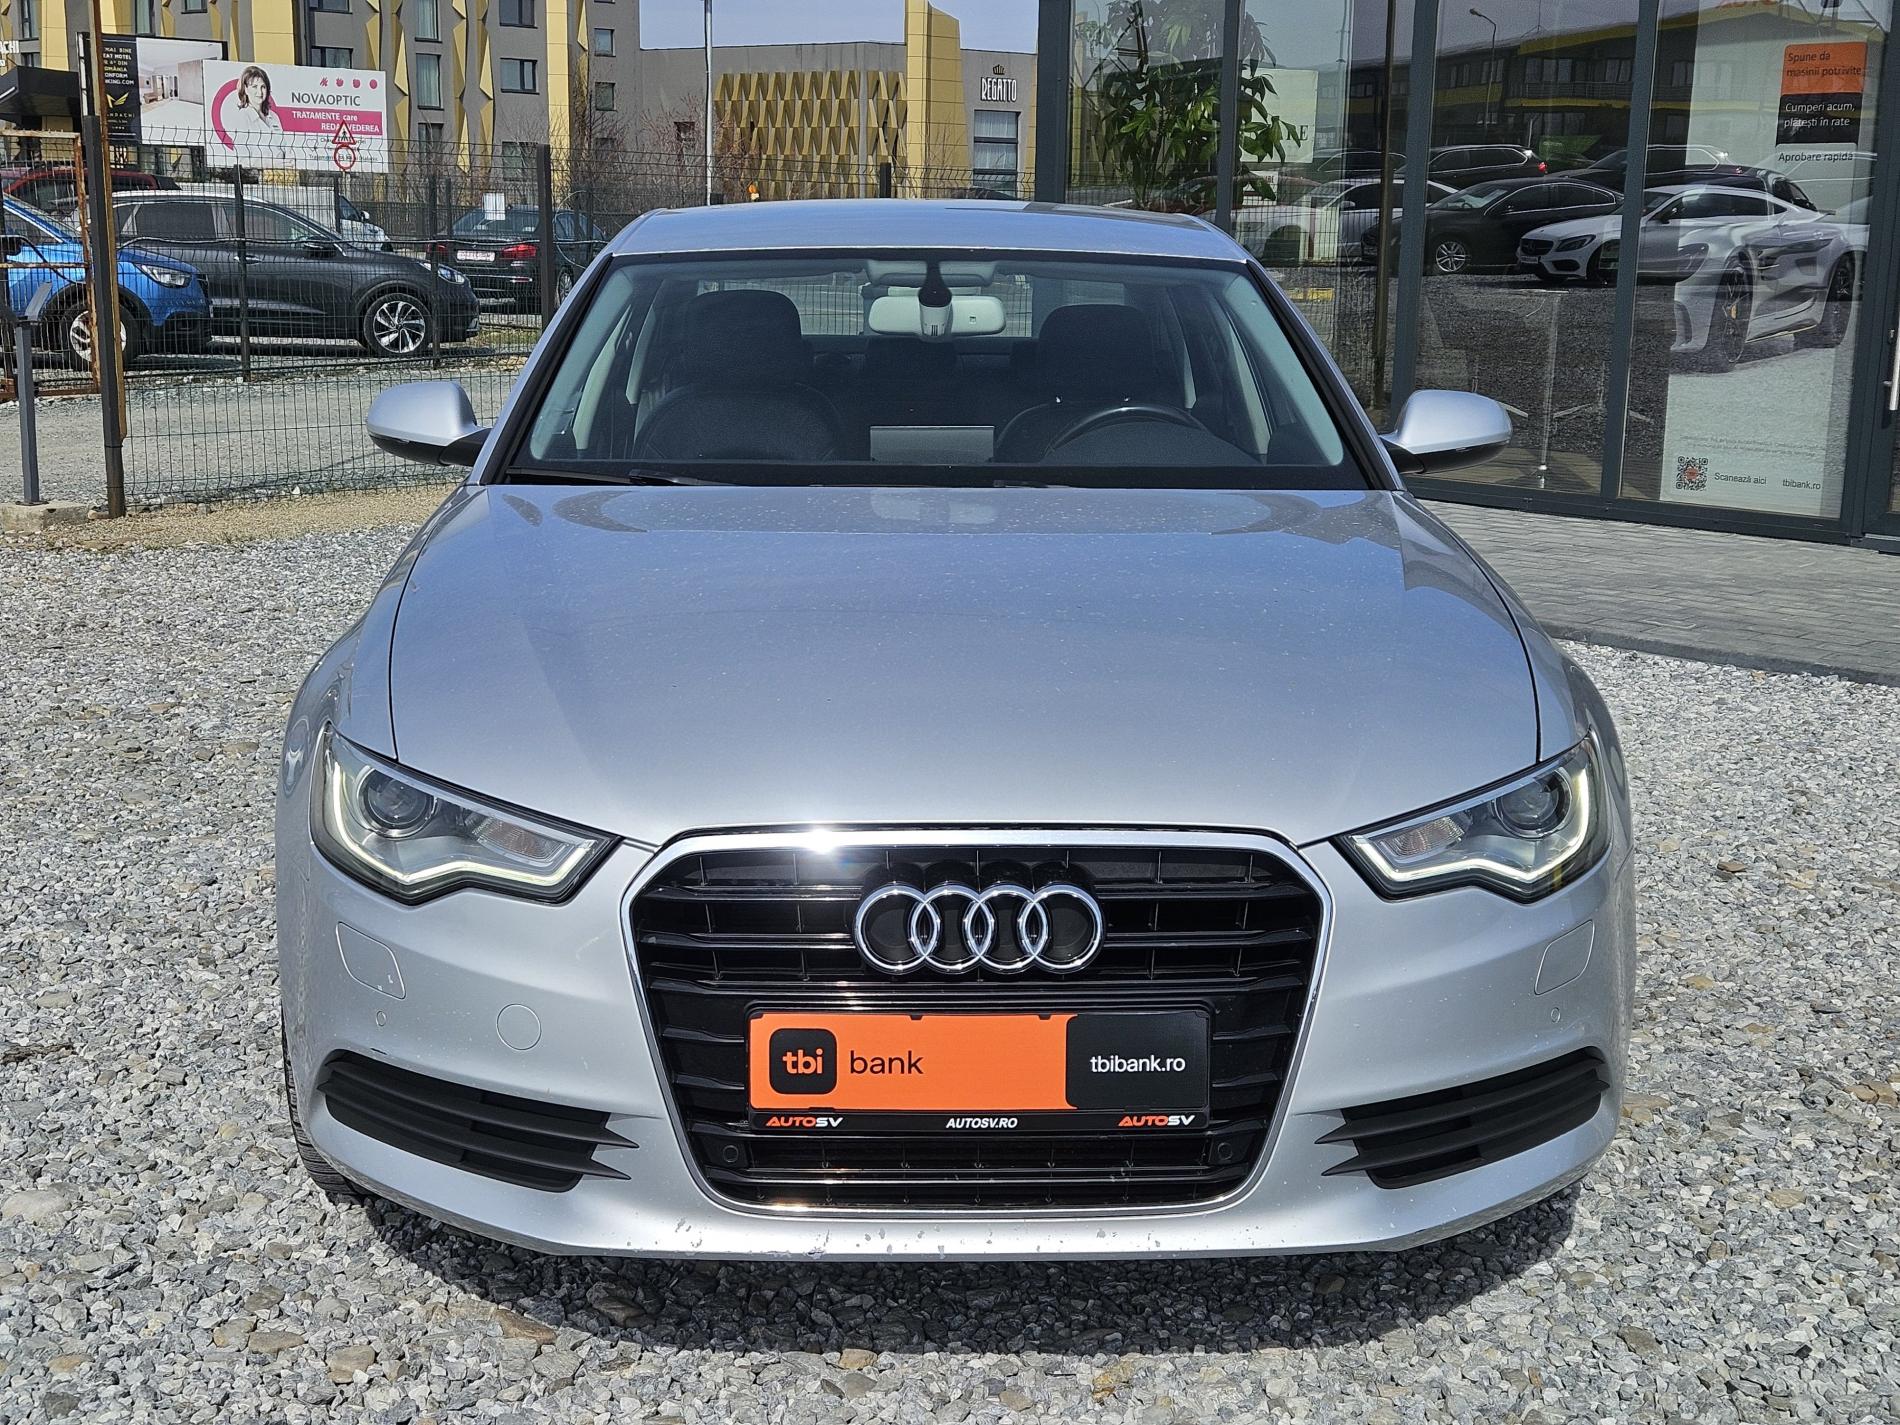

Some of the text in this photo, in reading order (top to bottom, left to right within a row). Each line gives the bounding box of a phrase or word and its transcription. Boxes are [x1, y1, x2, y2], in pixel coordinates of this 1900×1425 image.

[1788, 51, 1831, 64] Spune da
[1822, 66, 1862, 78] potrivite
[981, 77, 1017, 102] REGATTO
[291, 92, 361, 106] NOVAOPTIC
[1785, 102, 1855, 114] Cumperi acum,
[292, 111, 341, 120] TRATAMENTE
[1820, 117, 1829, 126] în
[1831, 118, 1850, 126] rate
[347, 124, 380, 132] VEDEREA
[1779, 152, 1821, 163] Aprobare
[1753, 476, 1767, 485] aici
[1782, 478, 1821, 490] tbibank.ro
[782, 1048, 924, 1075] tbi bank
[1090, 1054, 1186, 1073] tbibank.ro
[765, 1116, 844, 1127] AUTOSV
[945, 1117, 1018, 1129] AUTOSV.RO
[1118, 1115, 1195, 1127] AUTOSV
